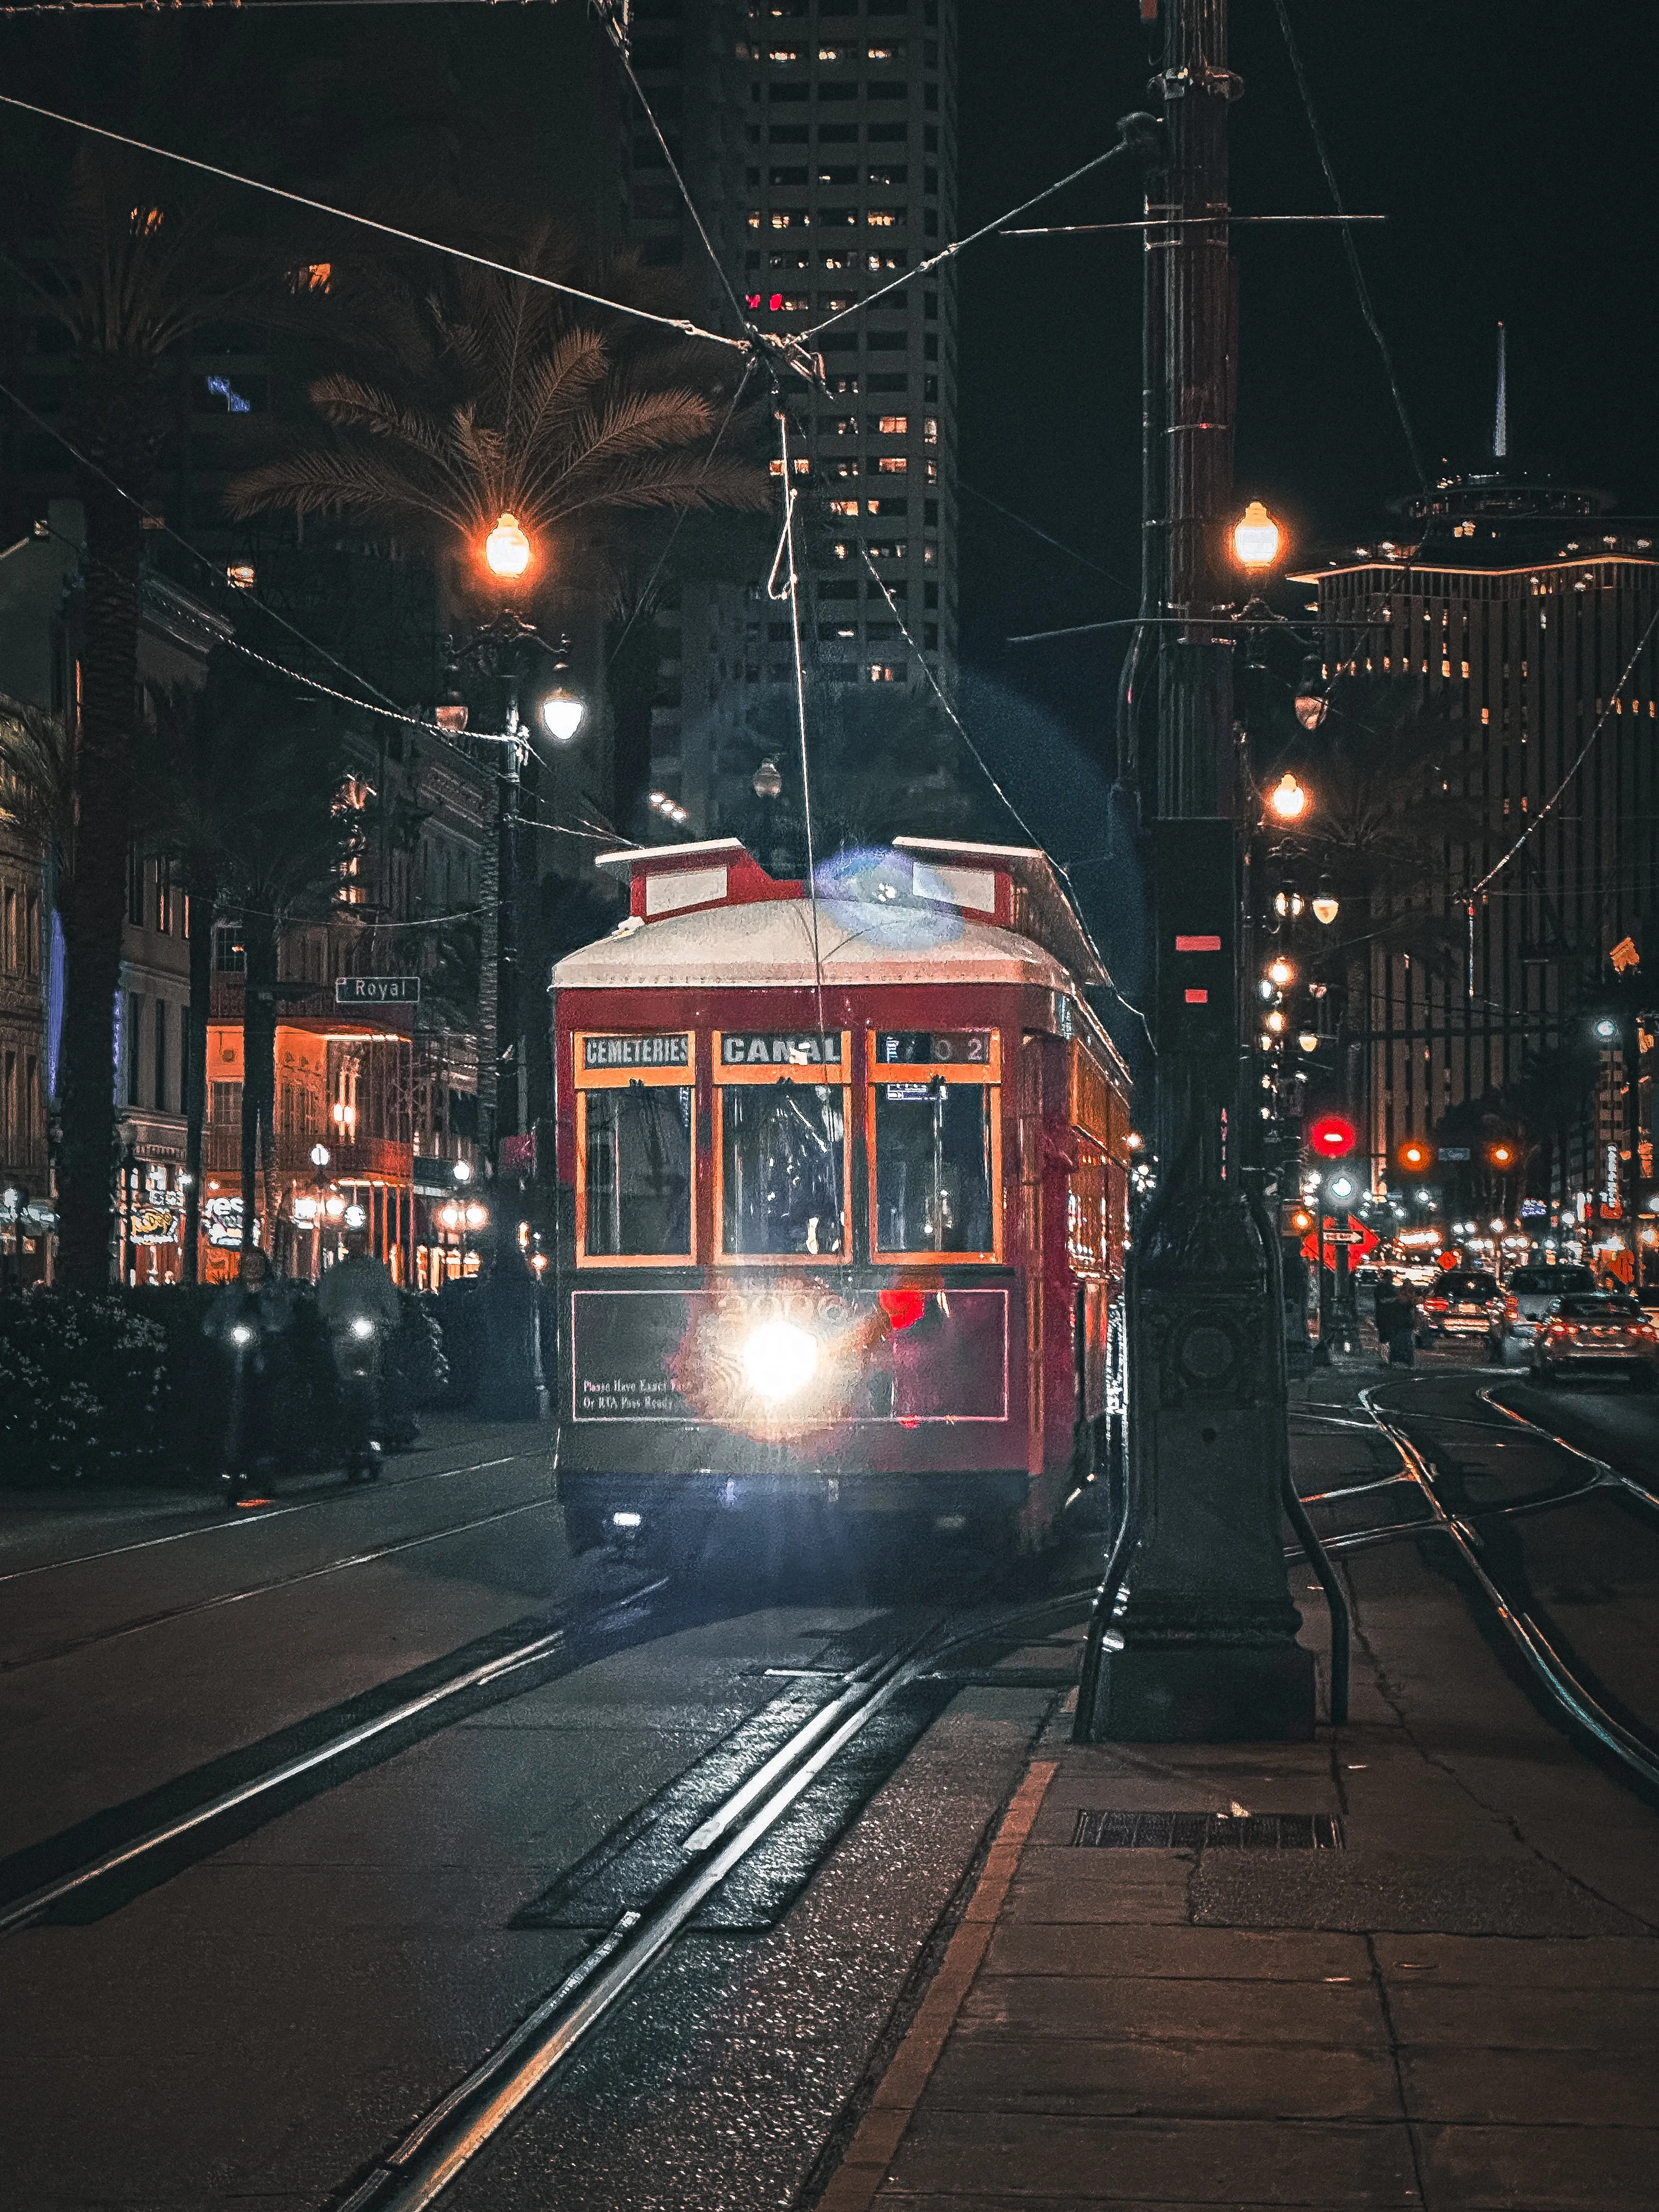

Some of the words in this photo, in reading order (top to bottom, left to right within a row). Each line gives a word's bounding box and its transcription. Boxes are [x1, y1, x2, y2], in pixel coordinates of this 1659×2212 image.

[356, 980, 405, 1001] Royal
[587, 1037, 688, 1063] CEMETERIES
[723, 1038, 841, 1062] CANAL
